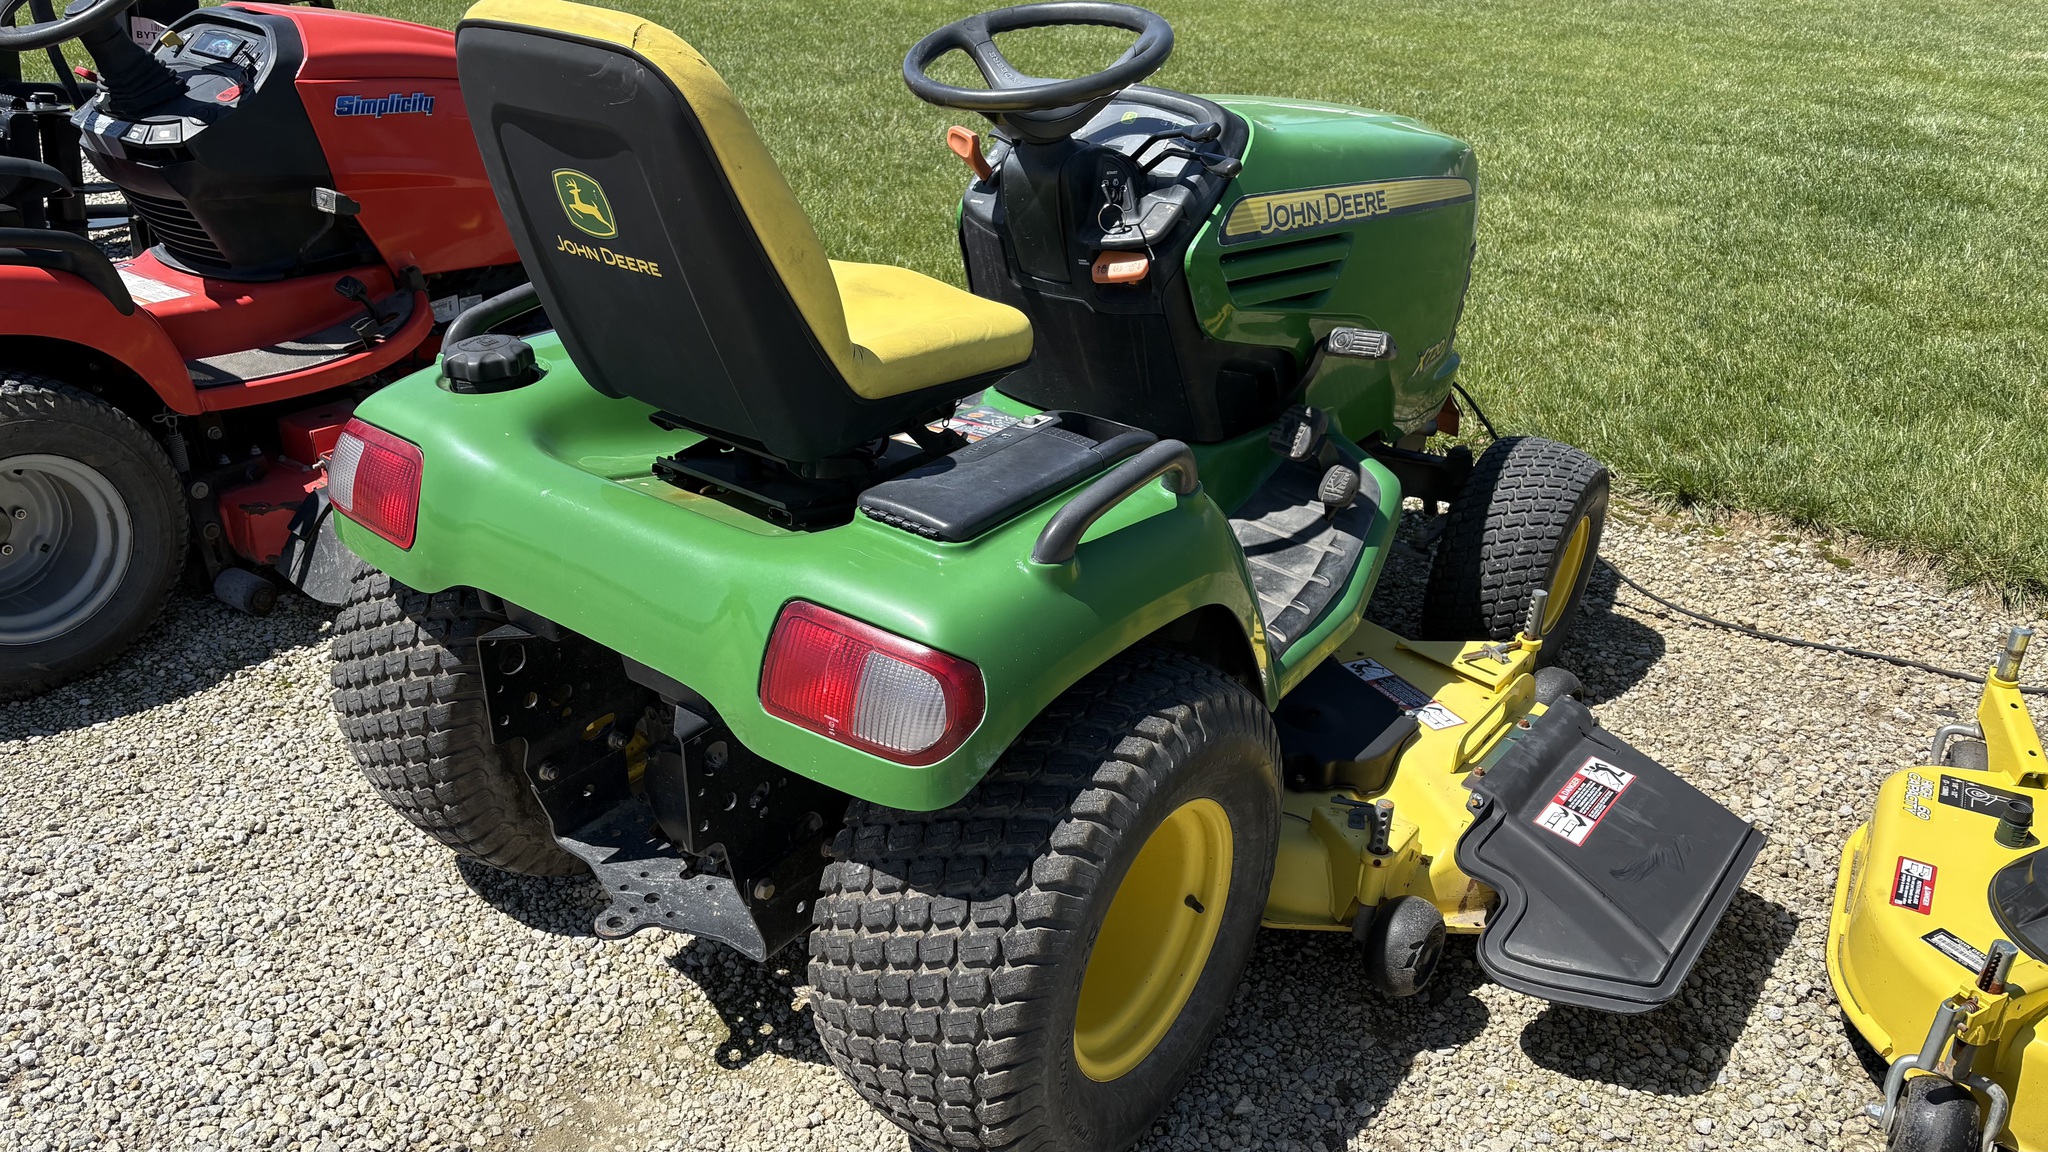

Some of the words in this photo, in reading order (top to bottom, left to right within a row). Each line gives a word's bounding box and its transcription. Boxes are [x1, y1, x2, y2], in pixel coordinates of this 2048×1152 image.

[334, 92, 435, 118] Simplicity
[1260, 200, 1323, 233] JOHN
[1324, 190, 1389, 222] DEERE
[557, 234, 601, 262] JOHN
[599, 246, 662, 277] DEERE
[1561, 776, 1581, 797] DANGER
[1903, 771, 1921, 816] CAPACITY
[1920, 777, 1935, 800] HIGH
[1917, 805, 1931, 821] 60
